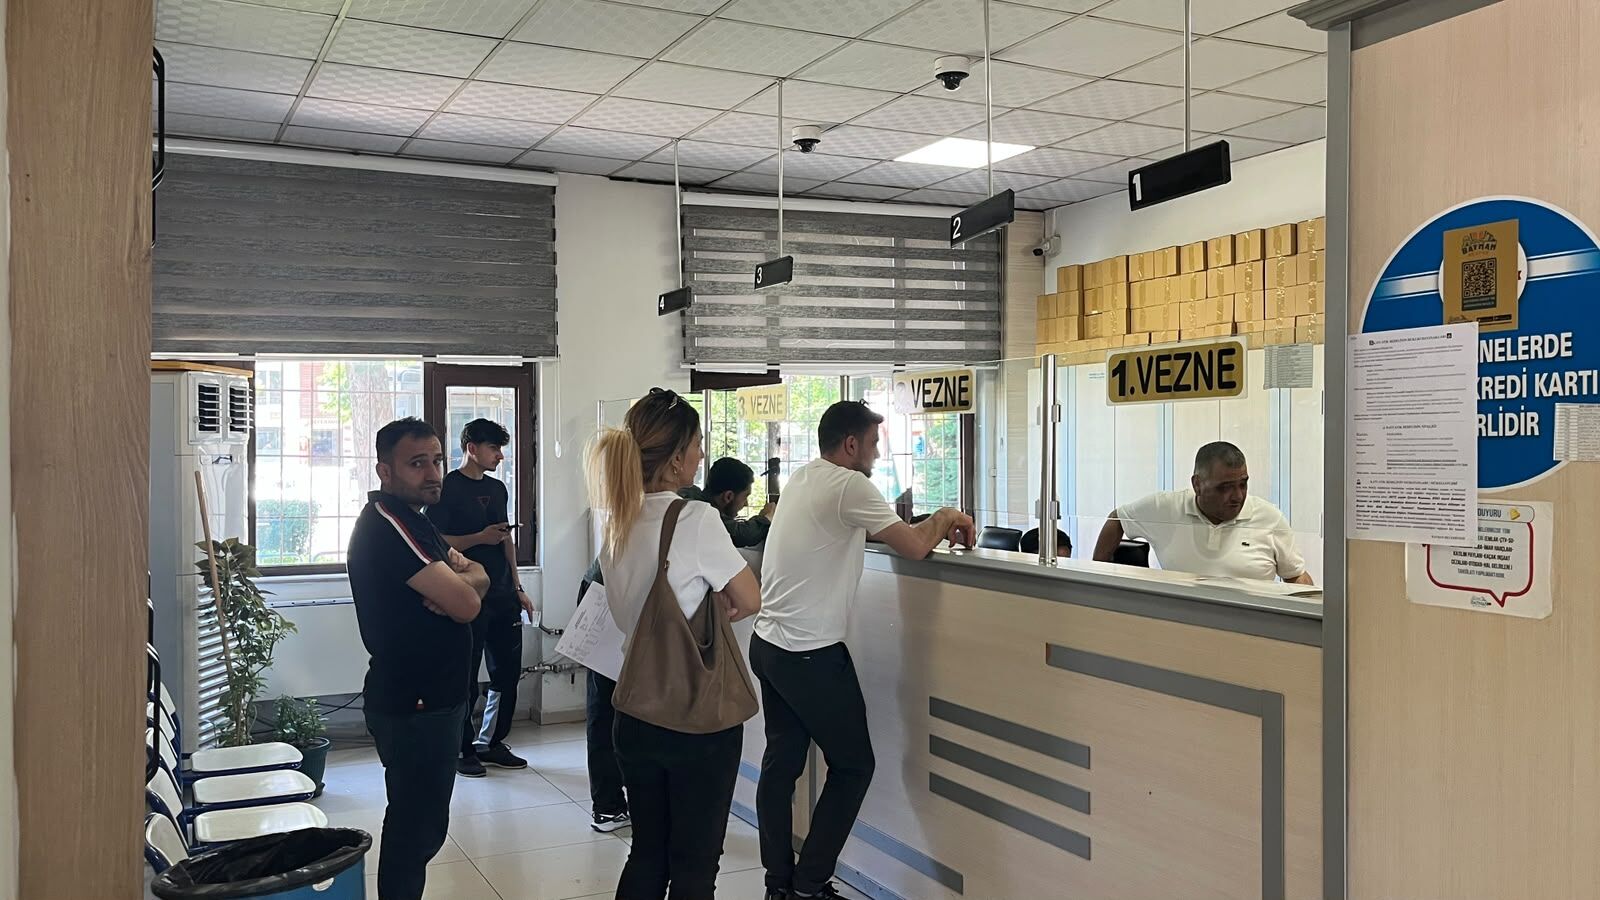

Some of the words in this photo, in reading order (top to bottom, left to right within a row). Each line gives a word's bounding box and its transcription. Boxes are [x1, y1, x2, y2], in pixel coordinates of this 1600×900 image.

[1133, 173, 1142, 201] 1
[953, 216, 961, 239] 2
[757, 266, 763, 284] 3
[660, 296, 665, 310] 4
[1479, 332, 1573, 363] NELERDE
[1112, 348, 1237, 397] 1.VEZNE
[1477, 367, 1527, 400] REDİ
[1535, 370, 1598, 397] KARTI
[751, 393, 783, 415] VEZNE
[911, 375, 970, 408] VEZNE
[1477, 405, 1540, 437] RLİDİR
[1477, 508, 1502, 517] DUYURU
